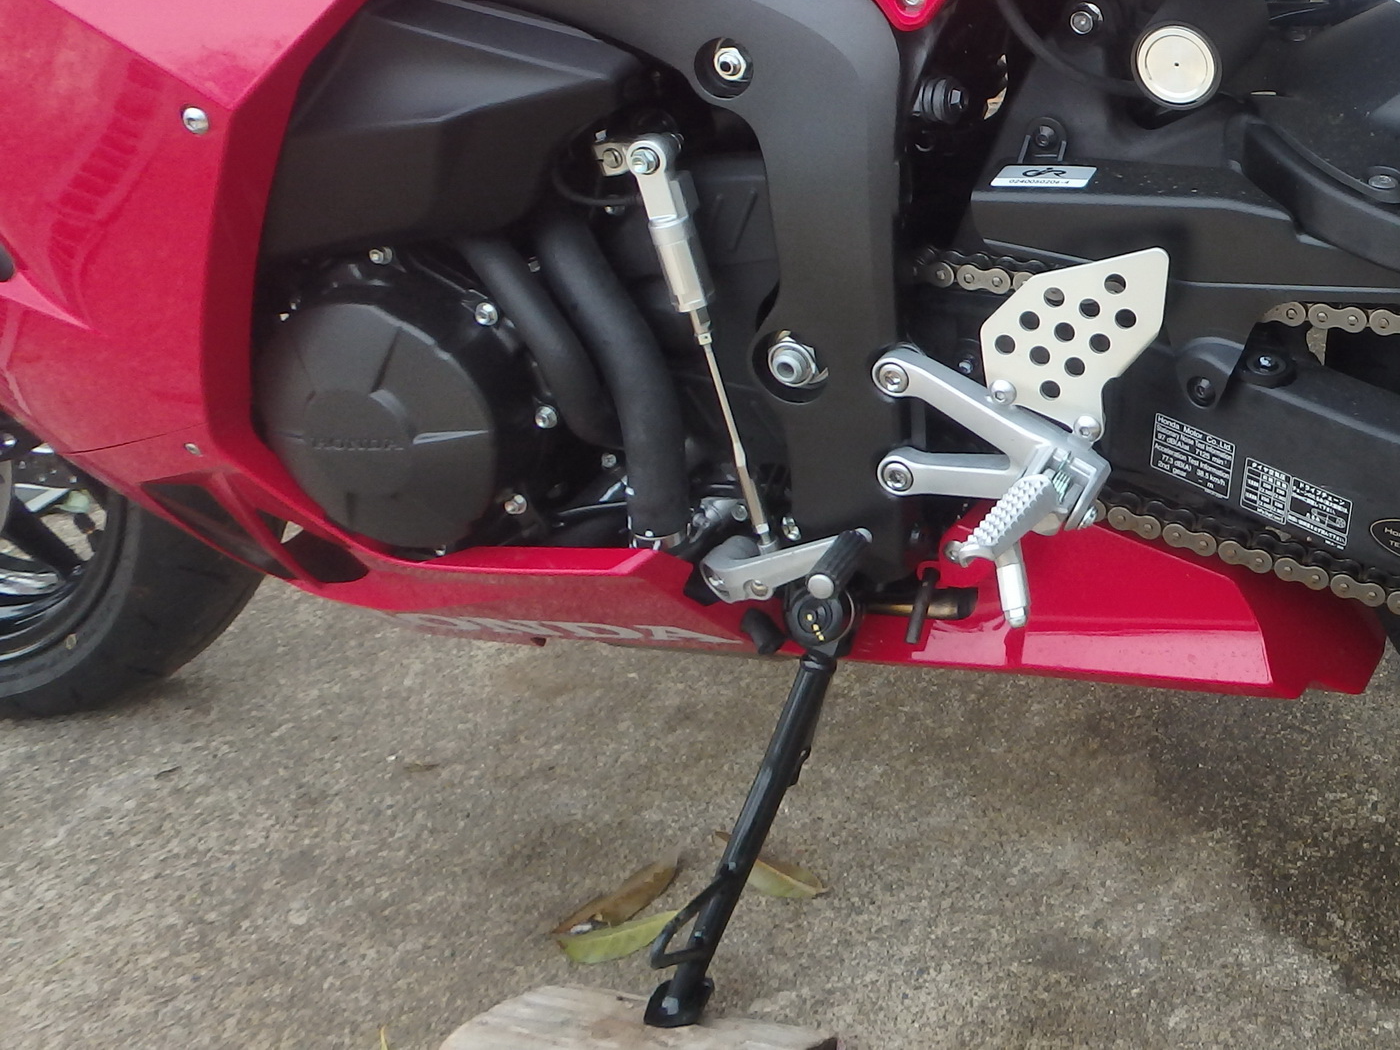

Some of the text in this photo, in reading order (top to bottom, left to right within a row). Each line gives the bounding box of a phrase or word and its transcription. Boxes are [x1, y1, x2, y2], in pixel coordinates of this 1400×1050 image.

[1158, 415, 1180, 430] Honda
[1183, 426, 1203, 439] Motor
[1195, 440, 1206, 450] Test
[1187, 455, 1199, 467] Test
[385, 612, 743, 645] ONDA
